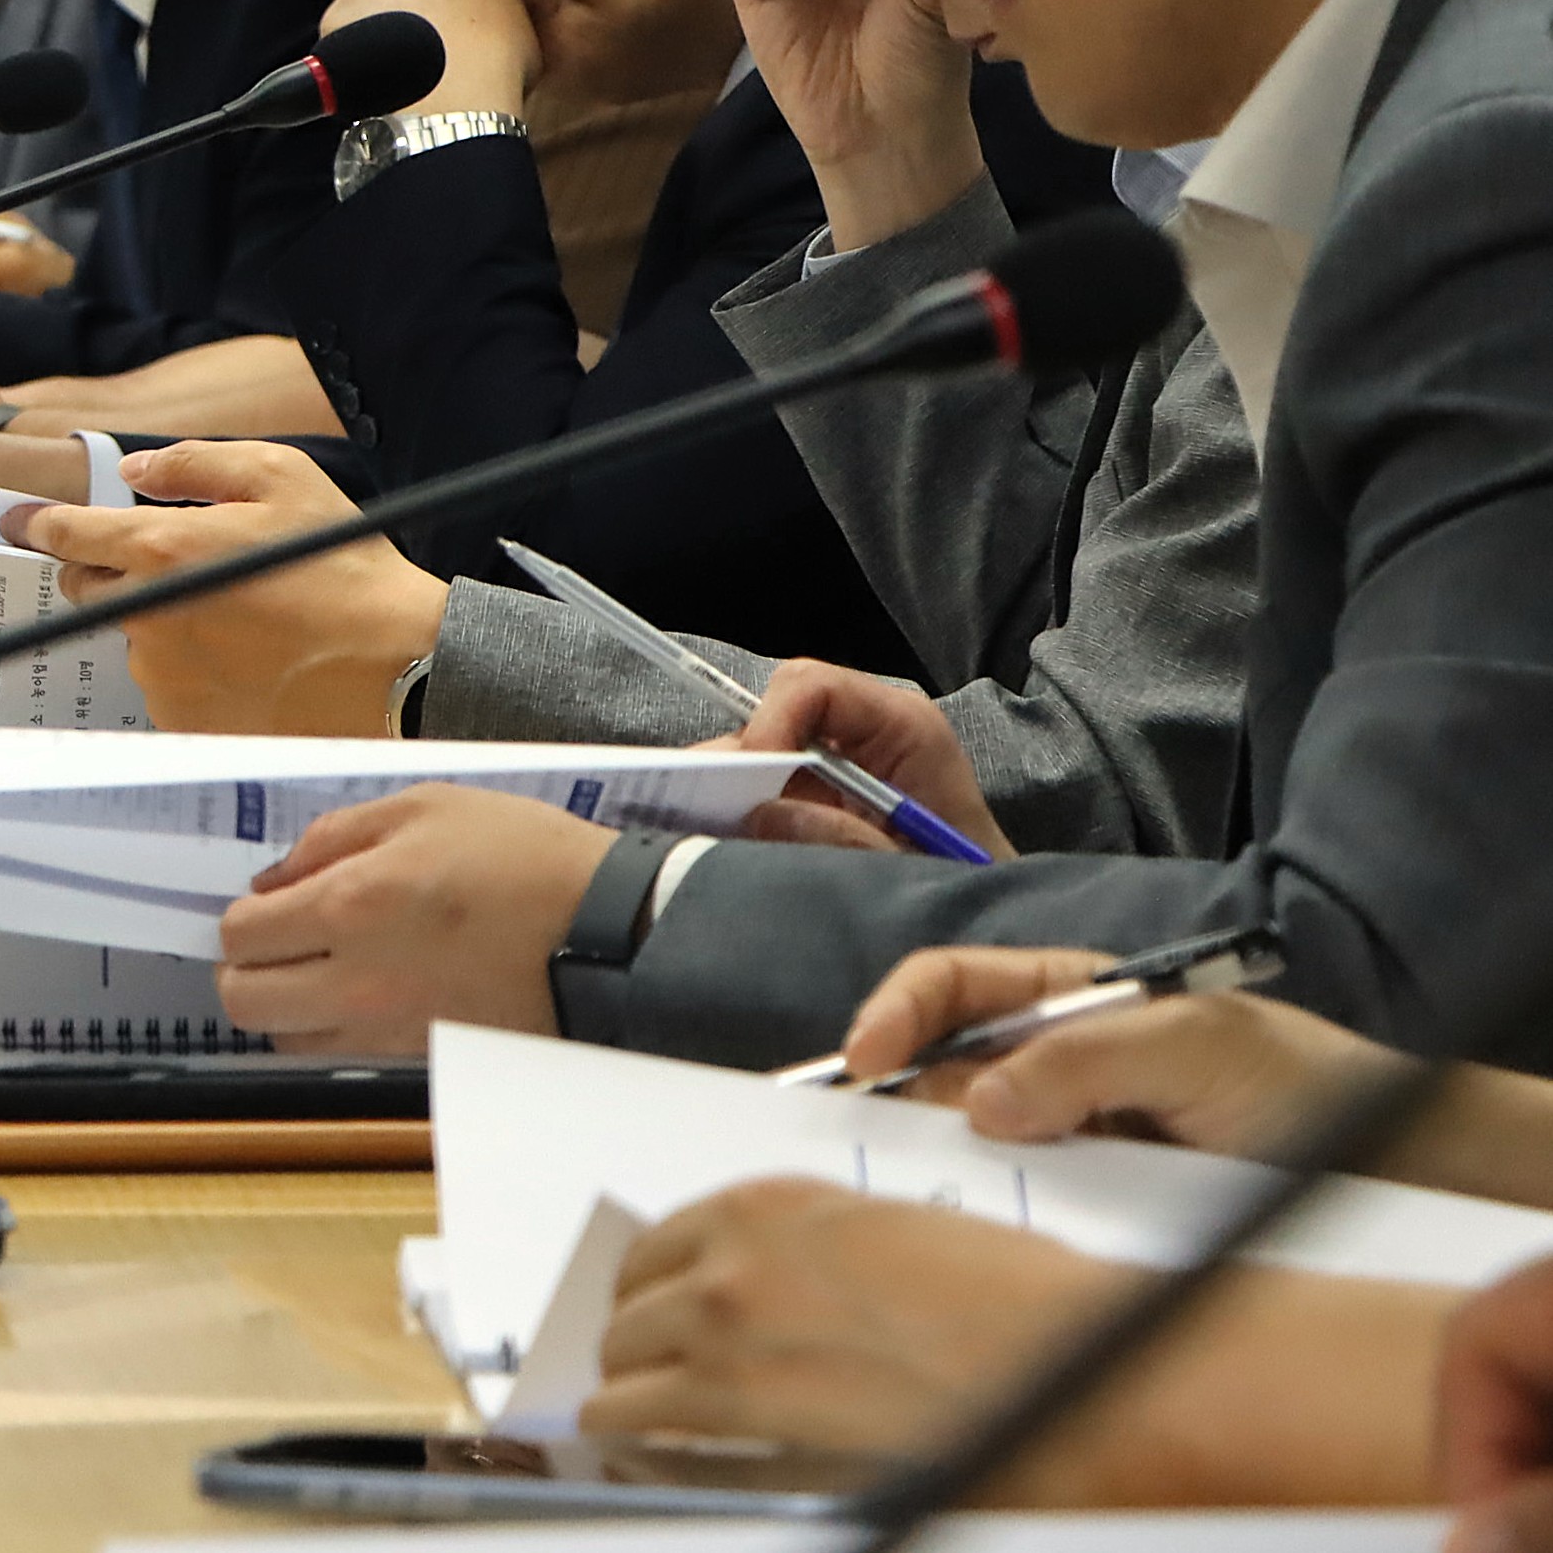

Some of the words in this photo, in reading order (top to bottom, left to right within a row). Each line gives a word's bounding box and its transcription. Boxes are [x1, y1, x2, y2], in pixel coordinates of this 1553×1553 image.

[79, 661, 93, 682] 10명
[75, 697, 91, 719] 위원
[30, 715, 43, 725] 소
